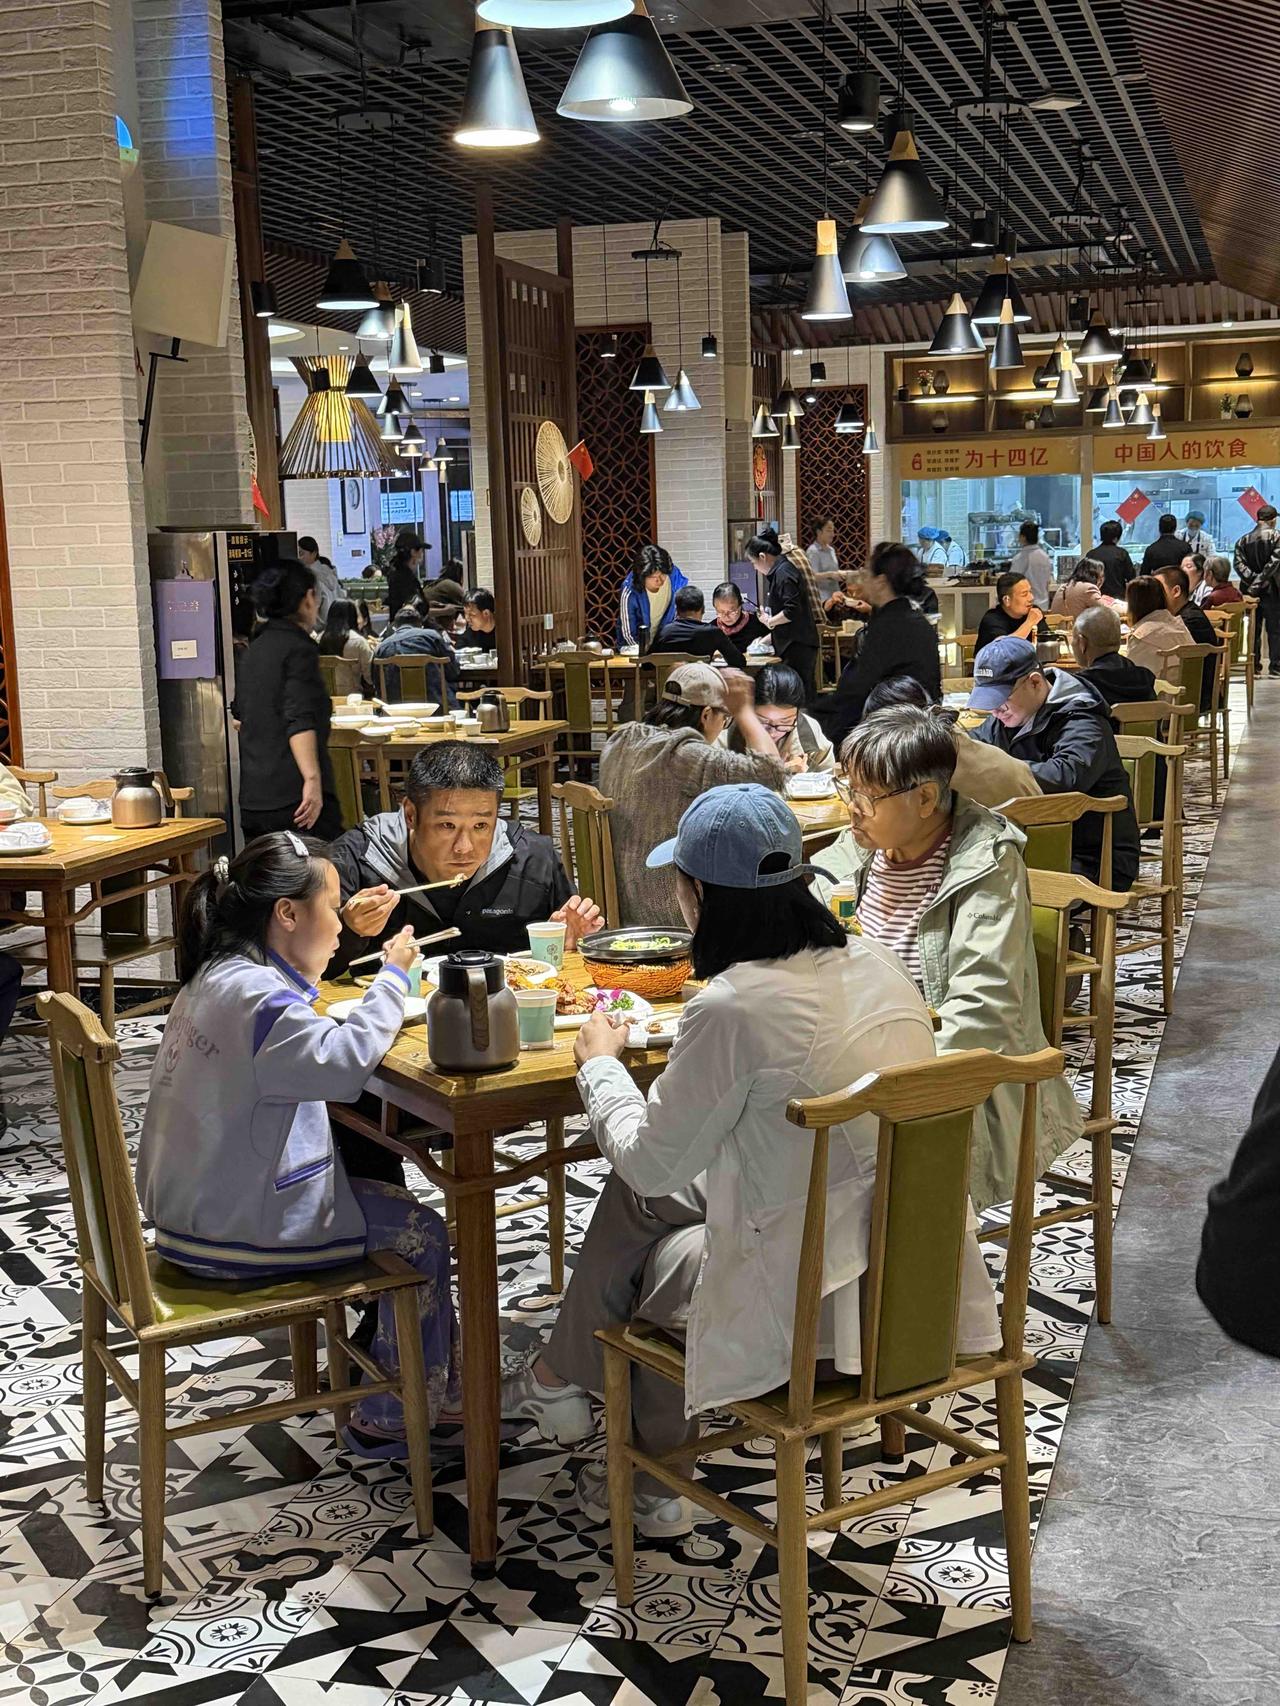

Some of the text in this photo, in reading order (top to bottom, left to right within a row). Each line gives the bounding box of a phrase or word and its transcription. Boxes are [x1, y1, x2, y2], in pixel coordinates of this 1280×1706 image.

[965, 447, 1049, 469] 为十四亿
[1114, 438, 1248, 464] 中国人的饮食
